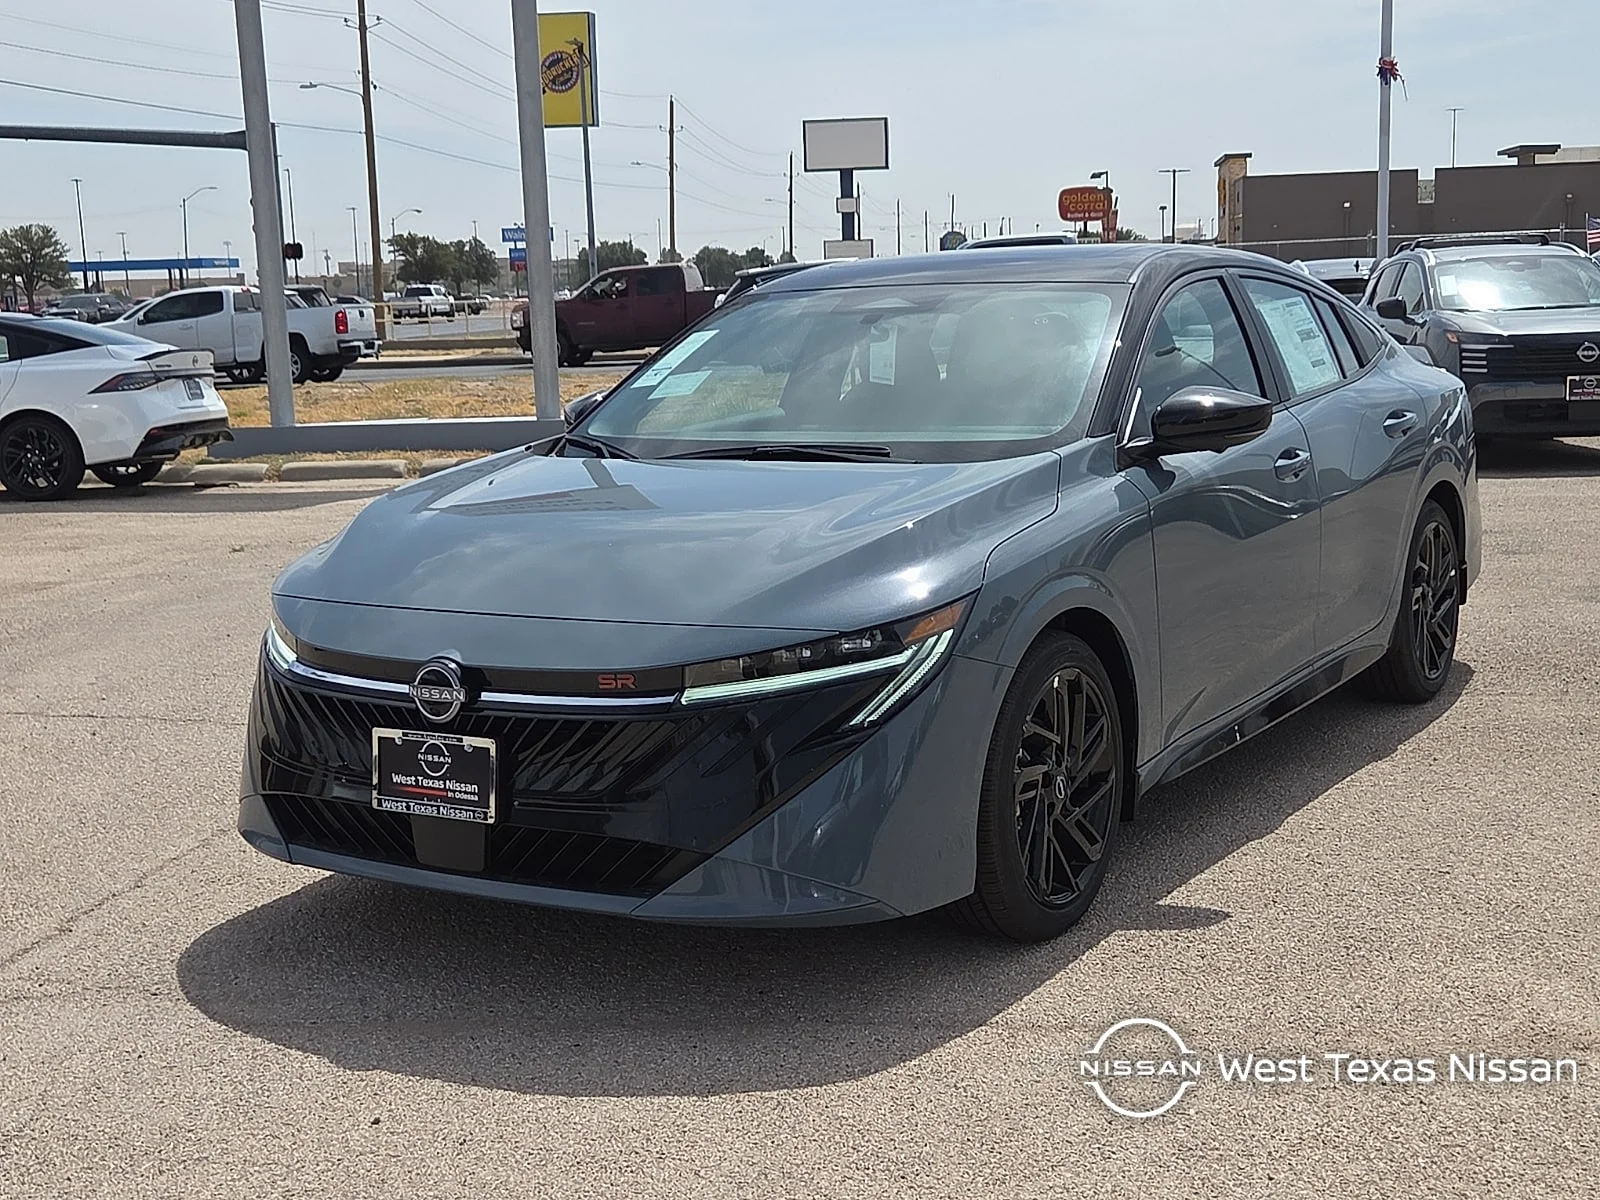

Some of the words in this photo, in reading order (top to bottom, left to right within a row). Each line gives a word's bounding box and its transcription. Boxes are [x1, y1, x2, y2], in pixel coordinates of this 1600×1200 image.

[1062, 193, 1104, 206] golden
[1069, 200, 1108, 211] corral
[598, 674, 636, 689] SR
[409, 685, 464, 700] NISSAN
[418, 753, 452, 764] NISSAN
[391, 773, 416, 786] West
[416, 776, 445, 789] Texas
[445, 779, 479, 793] Nissan
[455, 792, 479, 801] Odessa
[381, 798, 407, 810] West
[407, 802, 438, 815] Texas
[439, 806, 474, 819] Nissan
